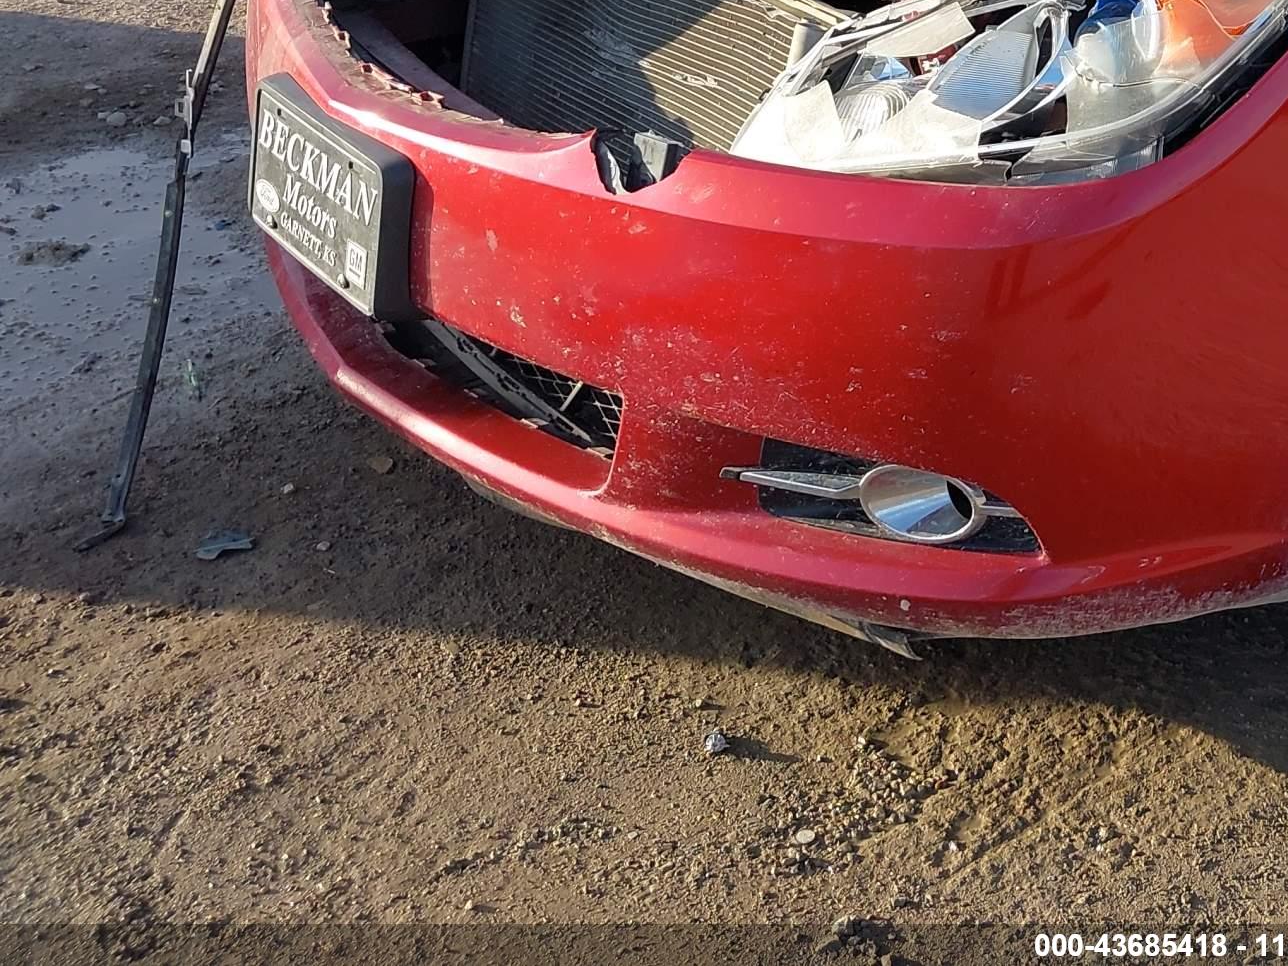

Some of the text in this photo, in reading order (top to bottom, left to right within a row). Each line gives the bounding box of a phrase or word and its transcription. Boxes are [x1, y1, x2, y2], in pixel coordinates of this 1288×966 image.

[258, 108, 379, 226] BECKMAN
[282, 173, 338, 238] Motors
[280, 211, 337, 267] GARNETT, KS
